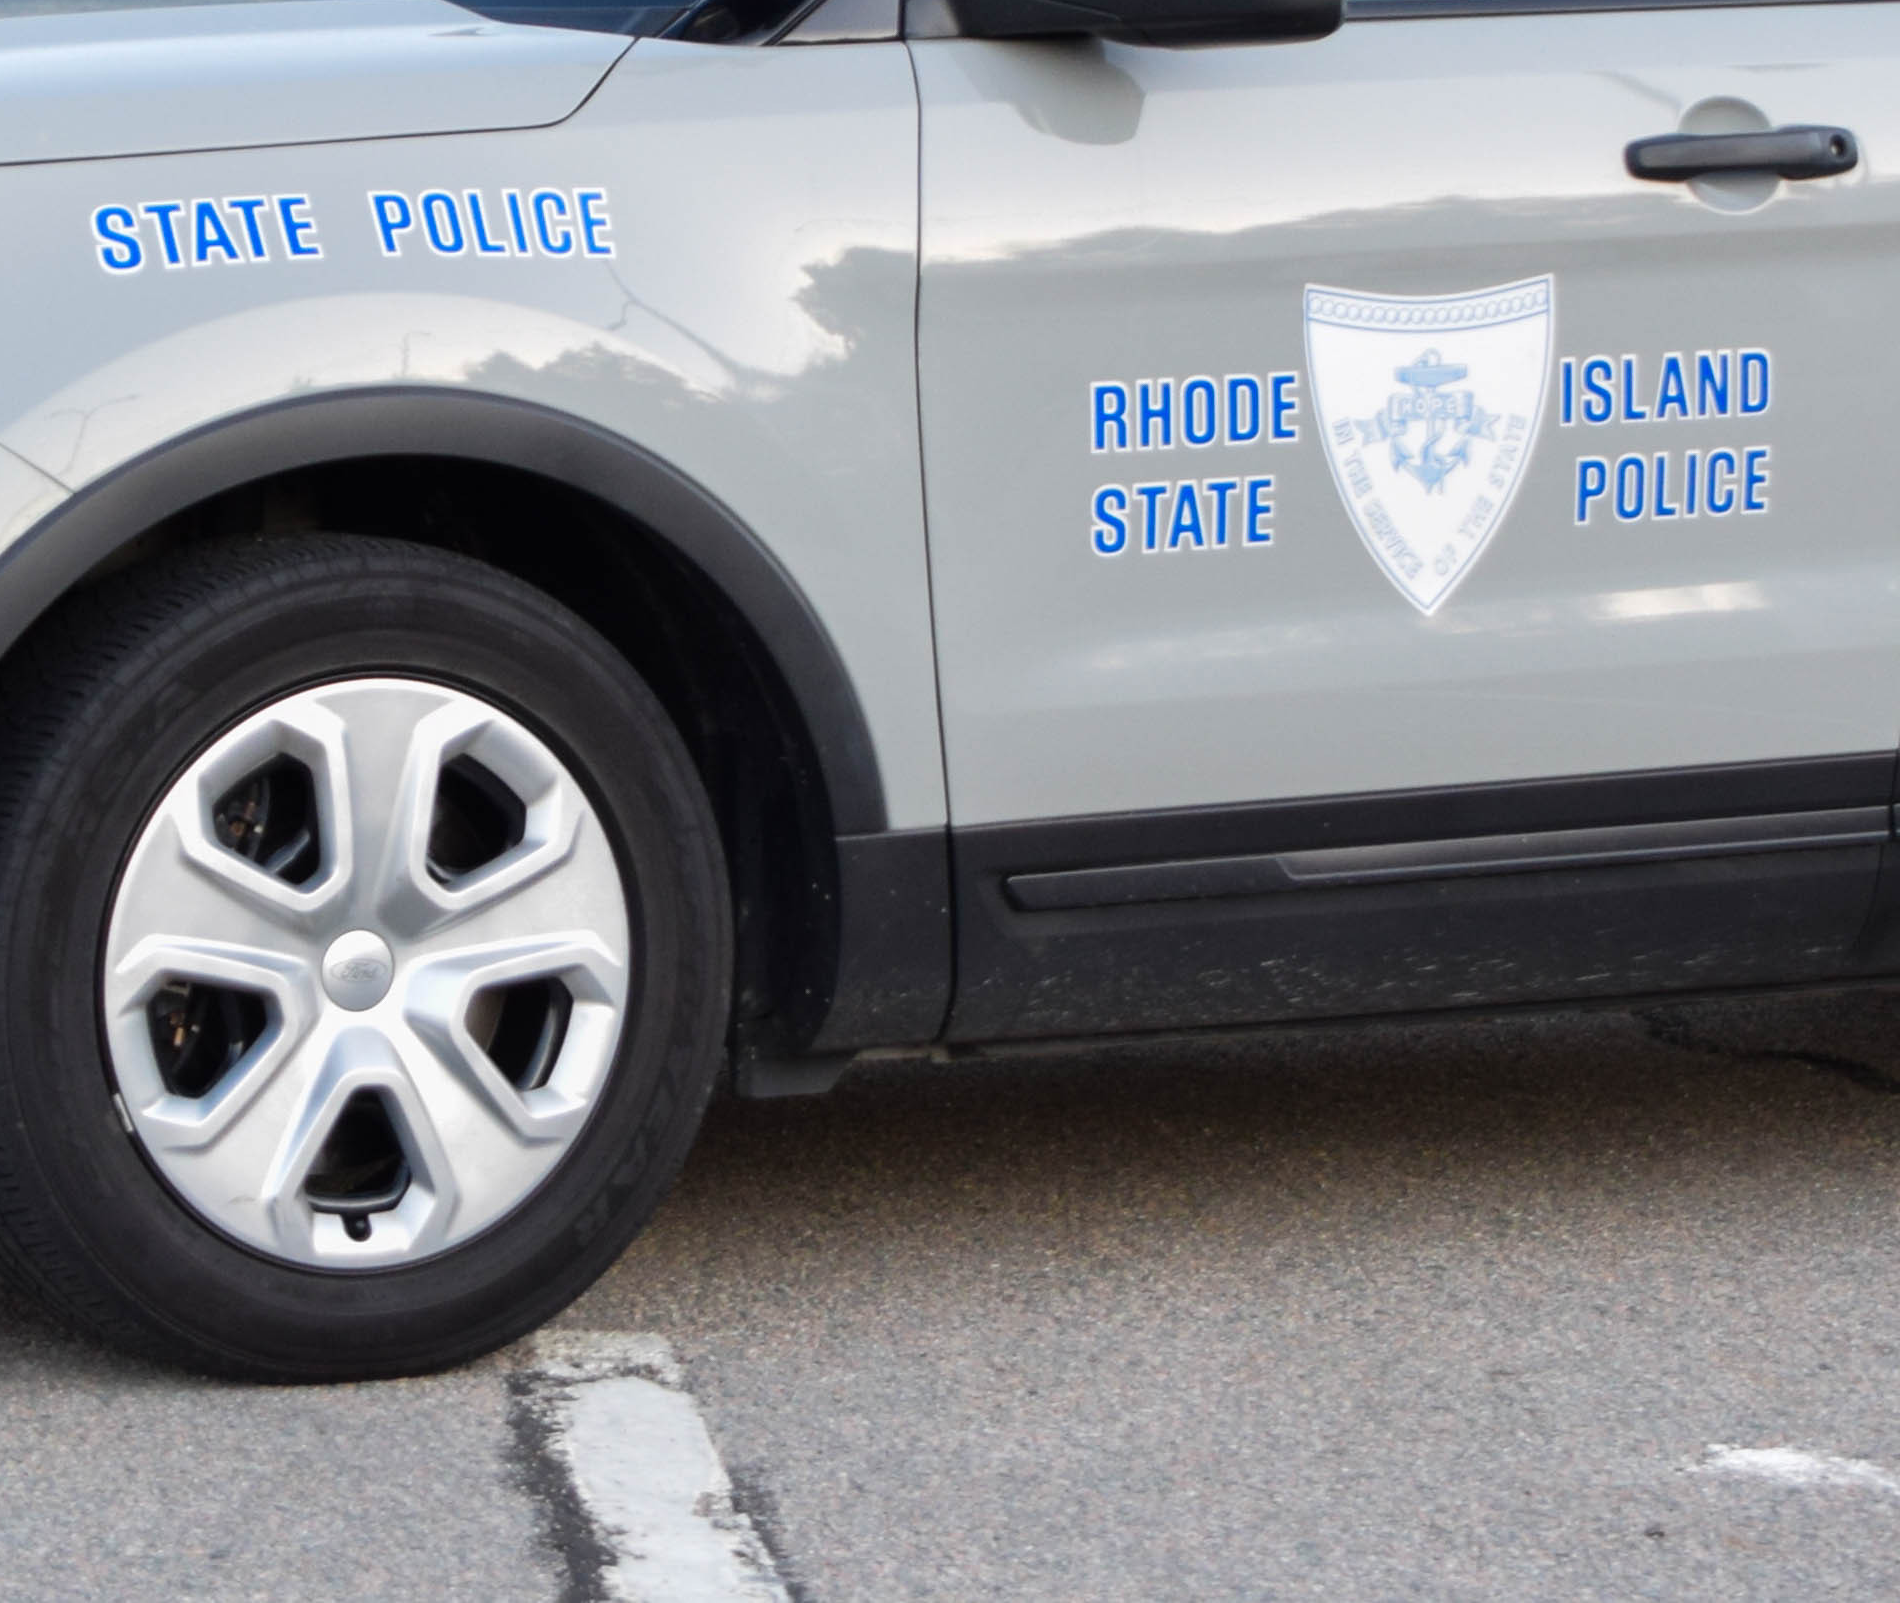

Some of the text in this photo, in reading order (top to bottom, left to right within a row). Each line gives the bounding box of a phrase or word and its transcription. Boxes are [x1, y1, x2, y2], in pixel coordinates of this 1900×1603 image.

[92, 188, 613, 273] STATE POLICE
[1091, 349, 1772, 452] RHODE ISLAND
[1403, 399, 1458, 415] HOPE
[1091, 447, 1770, 557] STATE POLICE
